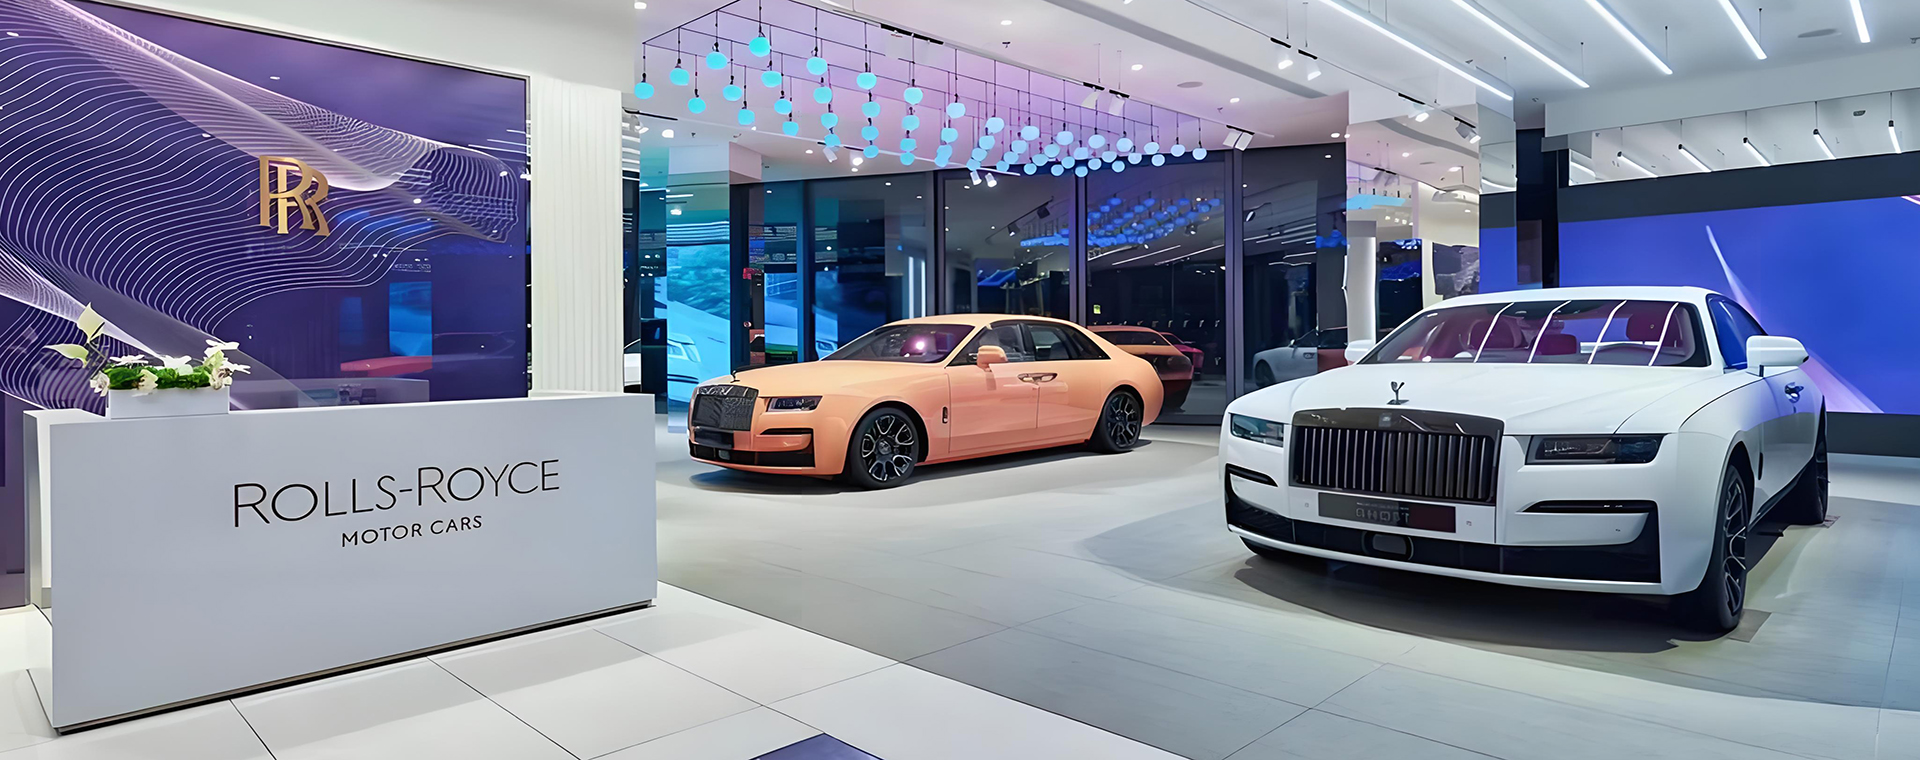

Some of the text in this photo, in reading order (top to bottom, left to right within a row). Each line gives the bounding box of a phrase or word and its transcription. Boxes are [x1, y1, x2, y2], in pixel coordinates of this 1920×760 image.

[234, 459, 560, 528] ROLLS-ROYCE
[341, 515, 482, 548] MOTOR CARS
